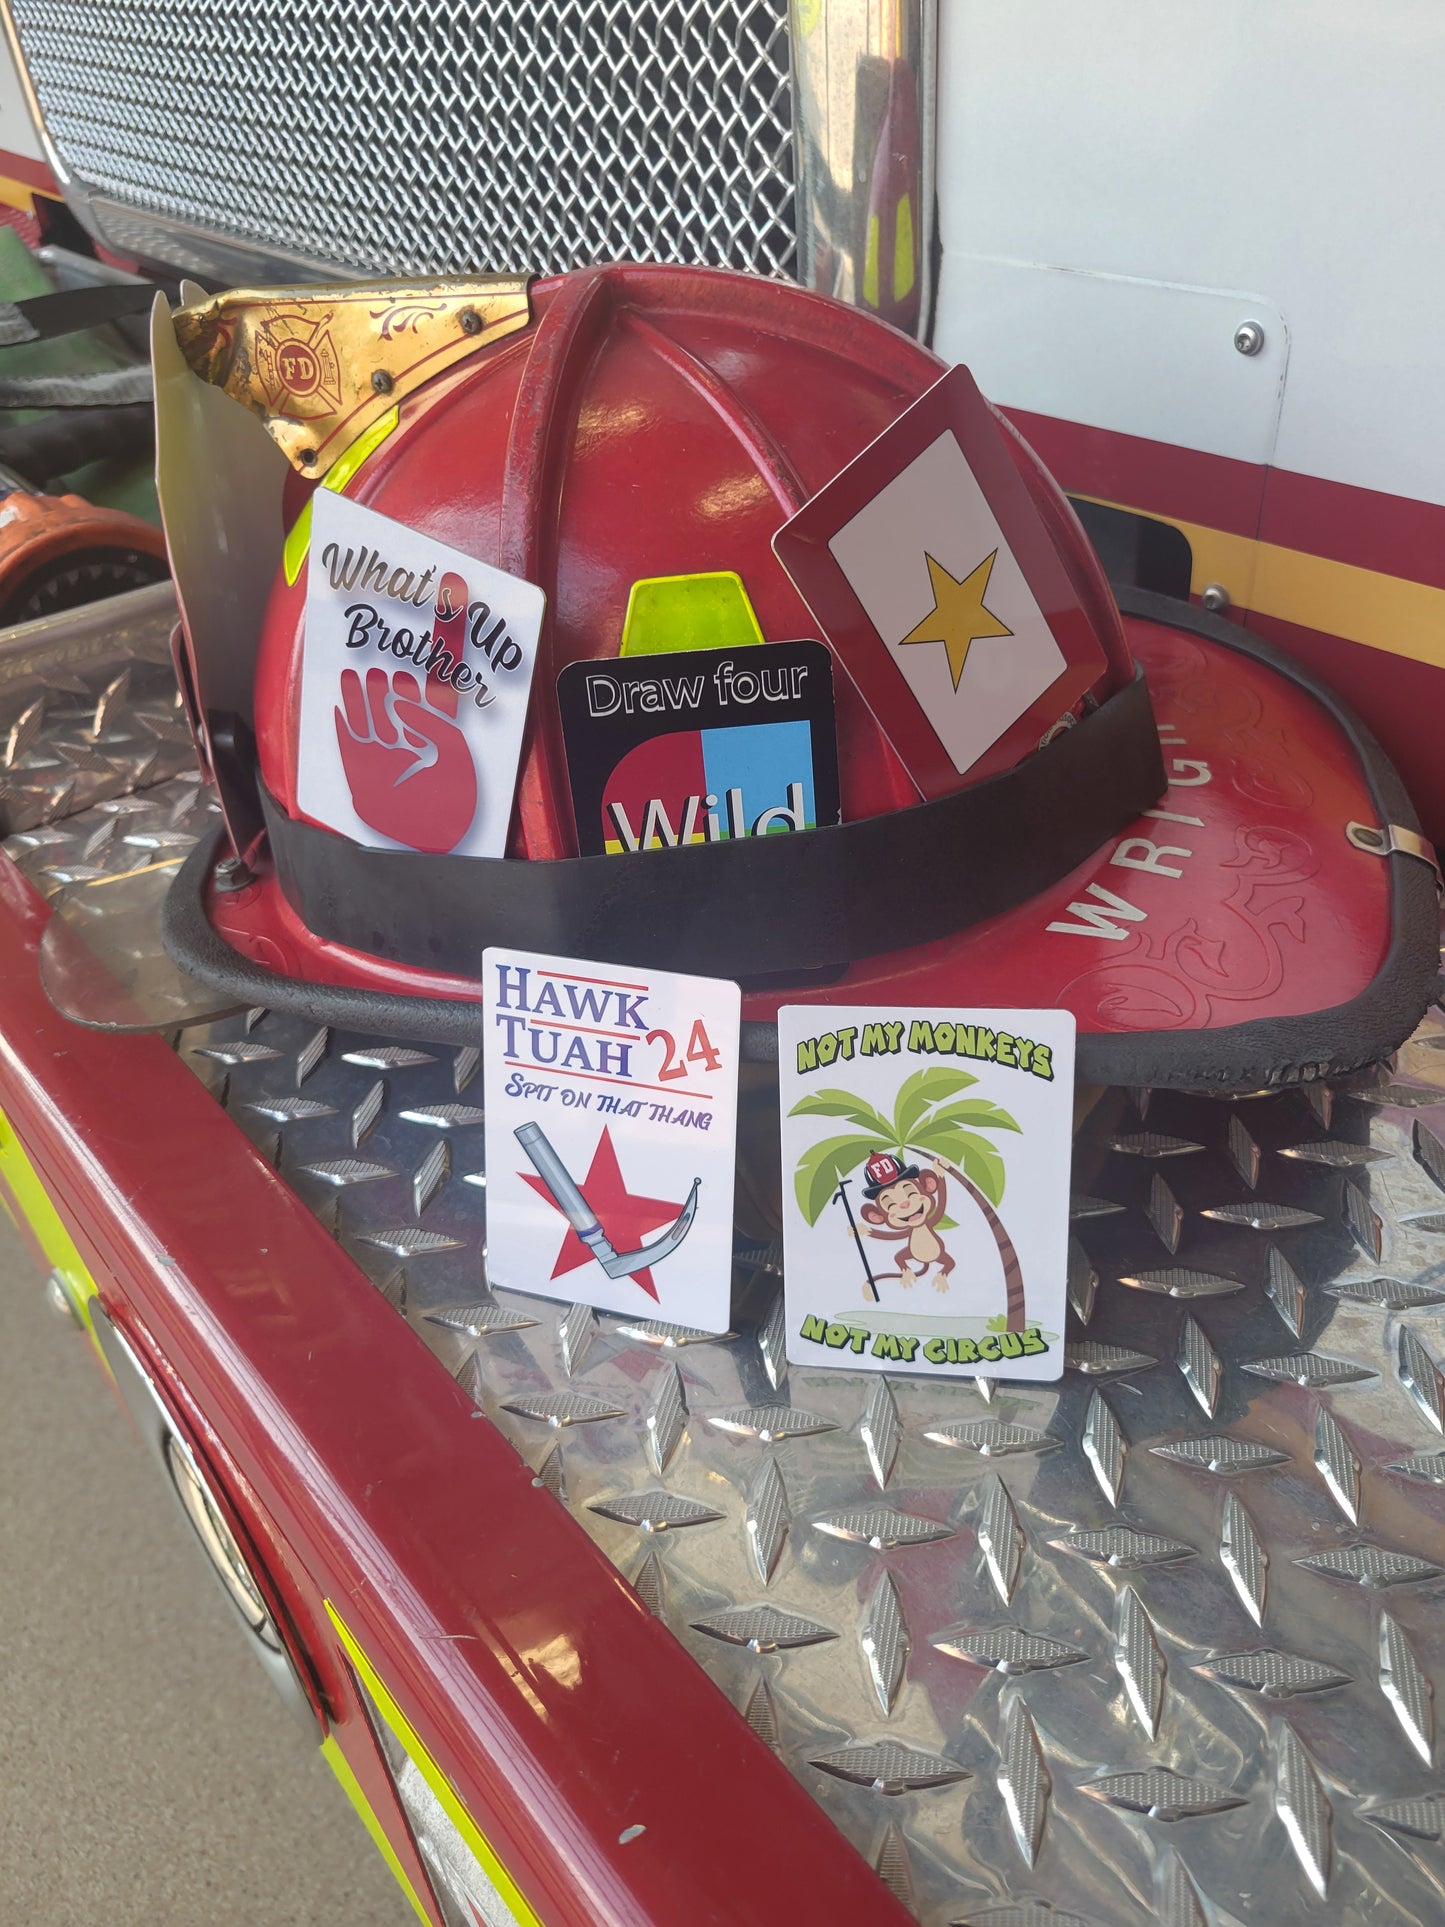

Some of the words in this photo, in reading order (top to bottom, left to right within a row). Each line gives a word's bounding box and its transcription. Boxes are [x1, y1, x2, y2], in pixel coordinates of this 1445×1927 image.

[281, 357, 315, 380] FD
[321, 542, 463, 622] What's
[467, 601, 523, 673] Up
[344, 603, 497, 708] Brother
[586, 674, 705, 718] Draw
[714, 661, 809, 706] four
[606, 782, 806, 852] Wild
[495, 964, 650, 1031] HAWK
[495, 1013, 633, 1077] TUAH
[645, 1018, 723, 1082] 24
[797, 1026, 858, 1075] NOT
[860, 1021, 905, 1056] MY
[907, 1020, 1055, 1082] MONKEYS
[504, 1072, 559, 1102] SPIT
[560, 1088, 593, 1110] ON
[596, 1094, 648, 1118] THAT
[649, 1103, 713, 1131] THANG
[870, 1158, 895, 1179] FD
[800, 1314, 871, 1354] NOT
[871, 1333, 920, 1363] MY
[923, 1327, 1050, 1364] CIRCUS
